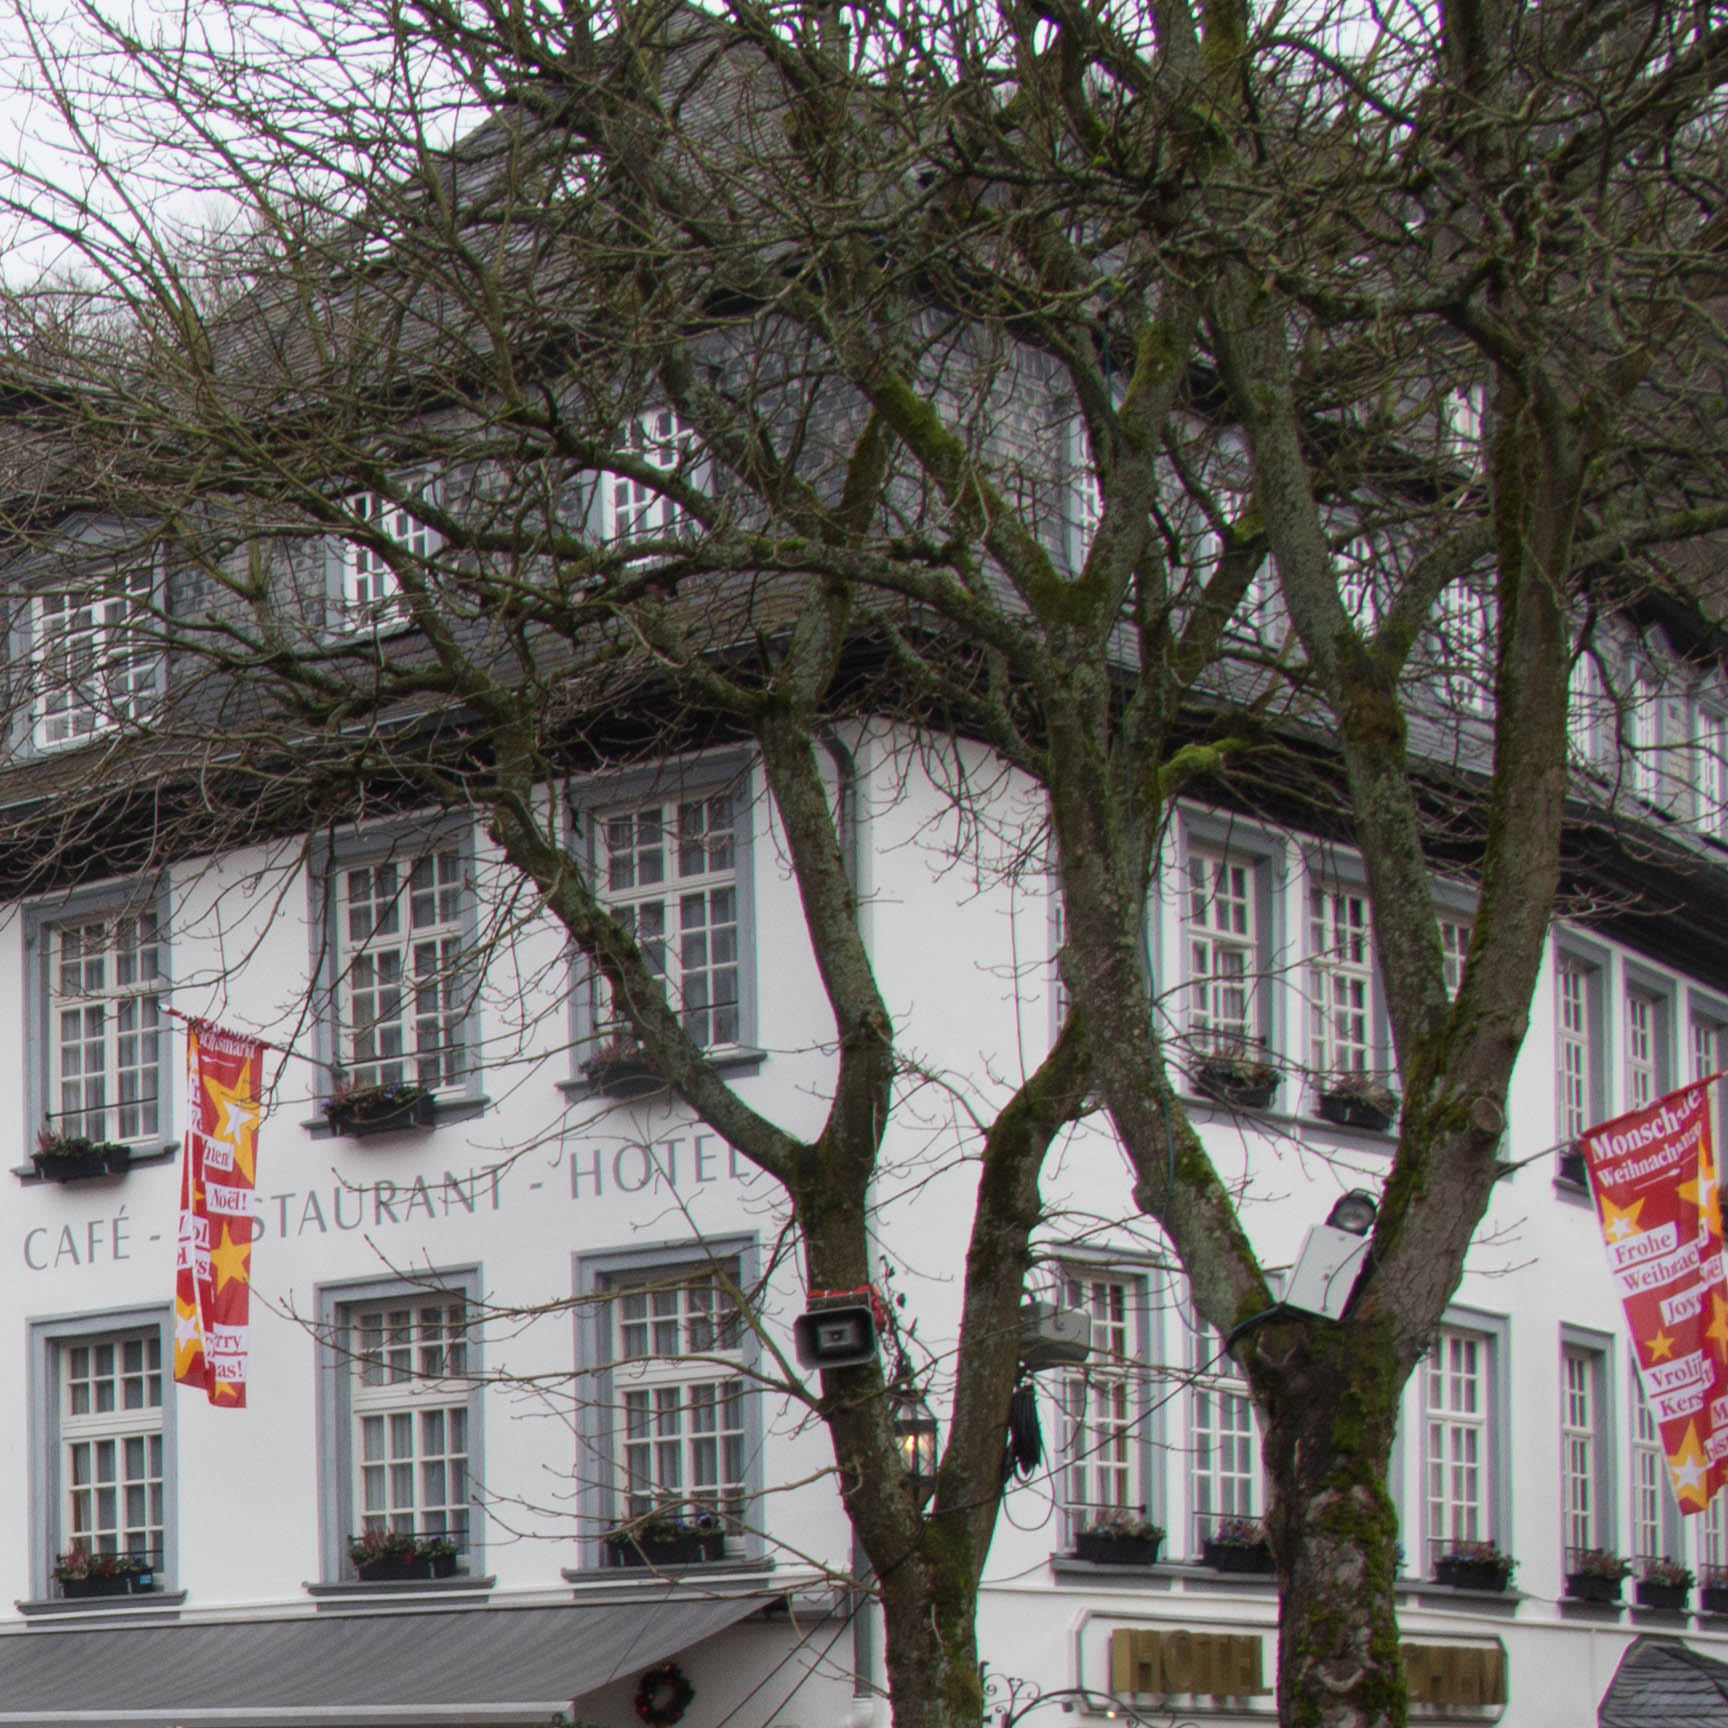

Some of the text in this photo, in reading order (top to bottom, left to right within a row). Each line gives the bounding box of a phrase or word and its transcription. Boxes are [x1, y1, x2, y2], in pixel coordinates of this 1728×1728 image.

[23, 1204, 131, 1271] CAFÉ
[250, 1164, 504, 1242] STAURANT
[570, 1134, 750, 1199] HOTEL
[210, 1188, 247, 1211] Noël!
[1614, 1232, 1672, 1264] Frohe
[1660, 1392, 1704, 1417] Kers
[1112, 1629, 1274, 1697] HOTEL
